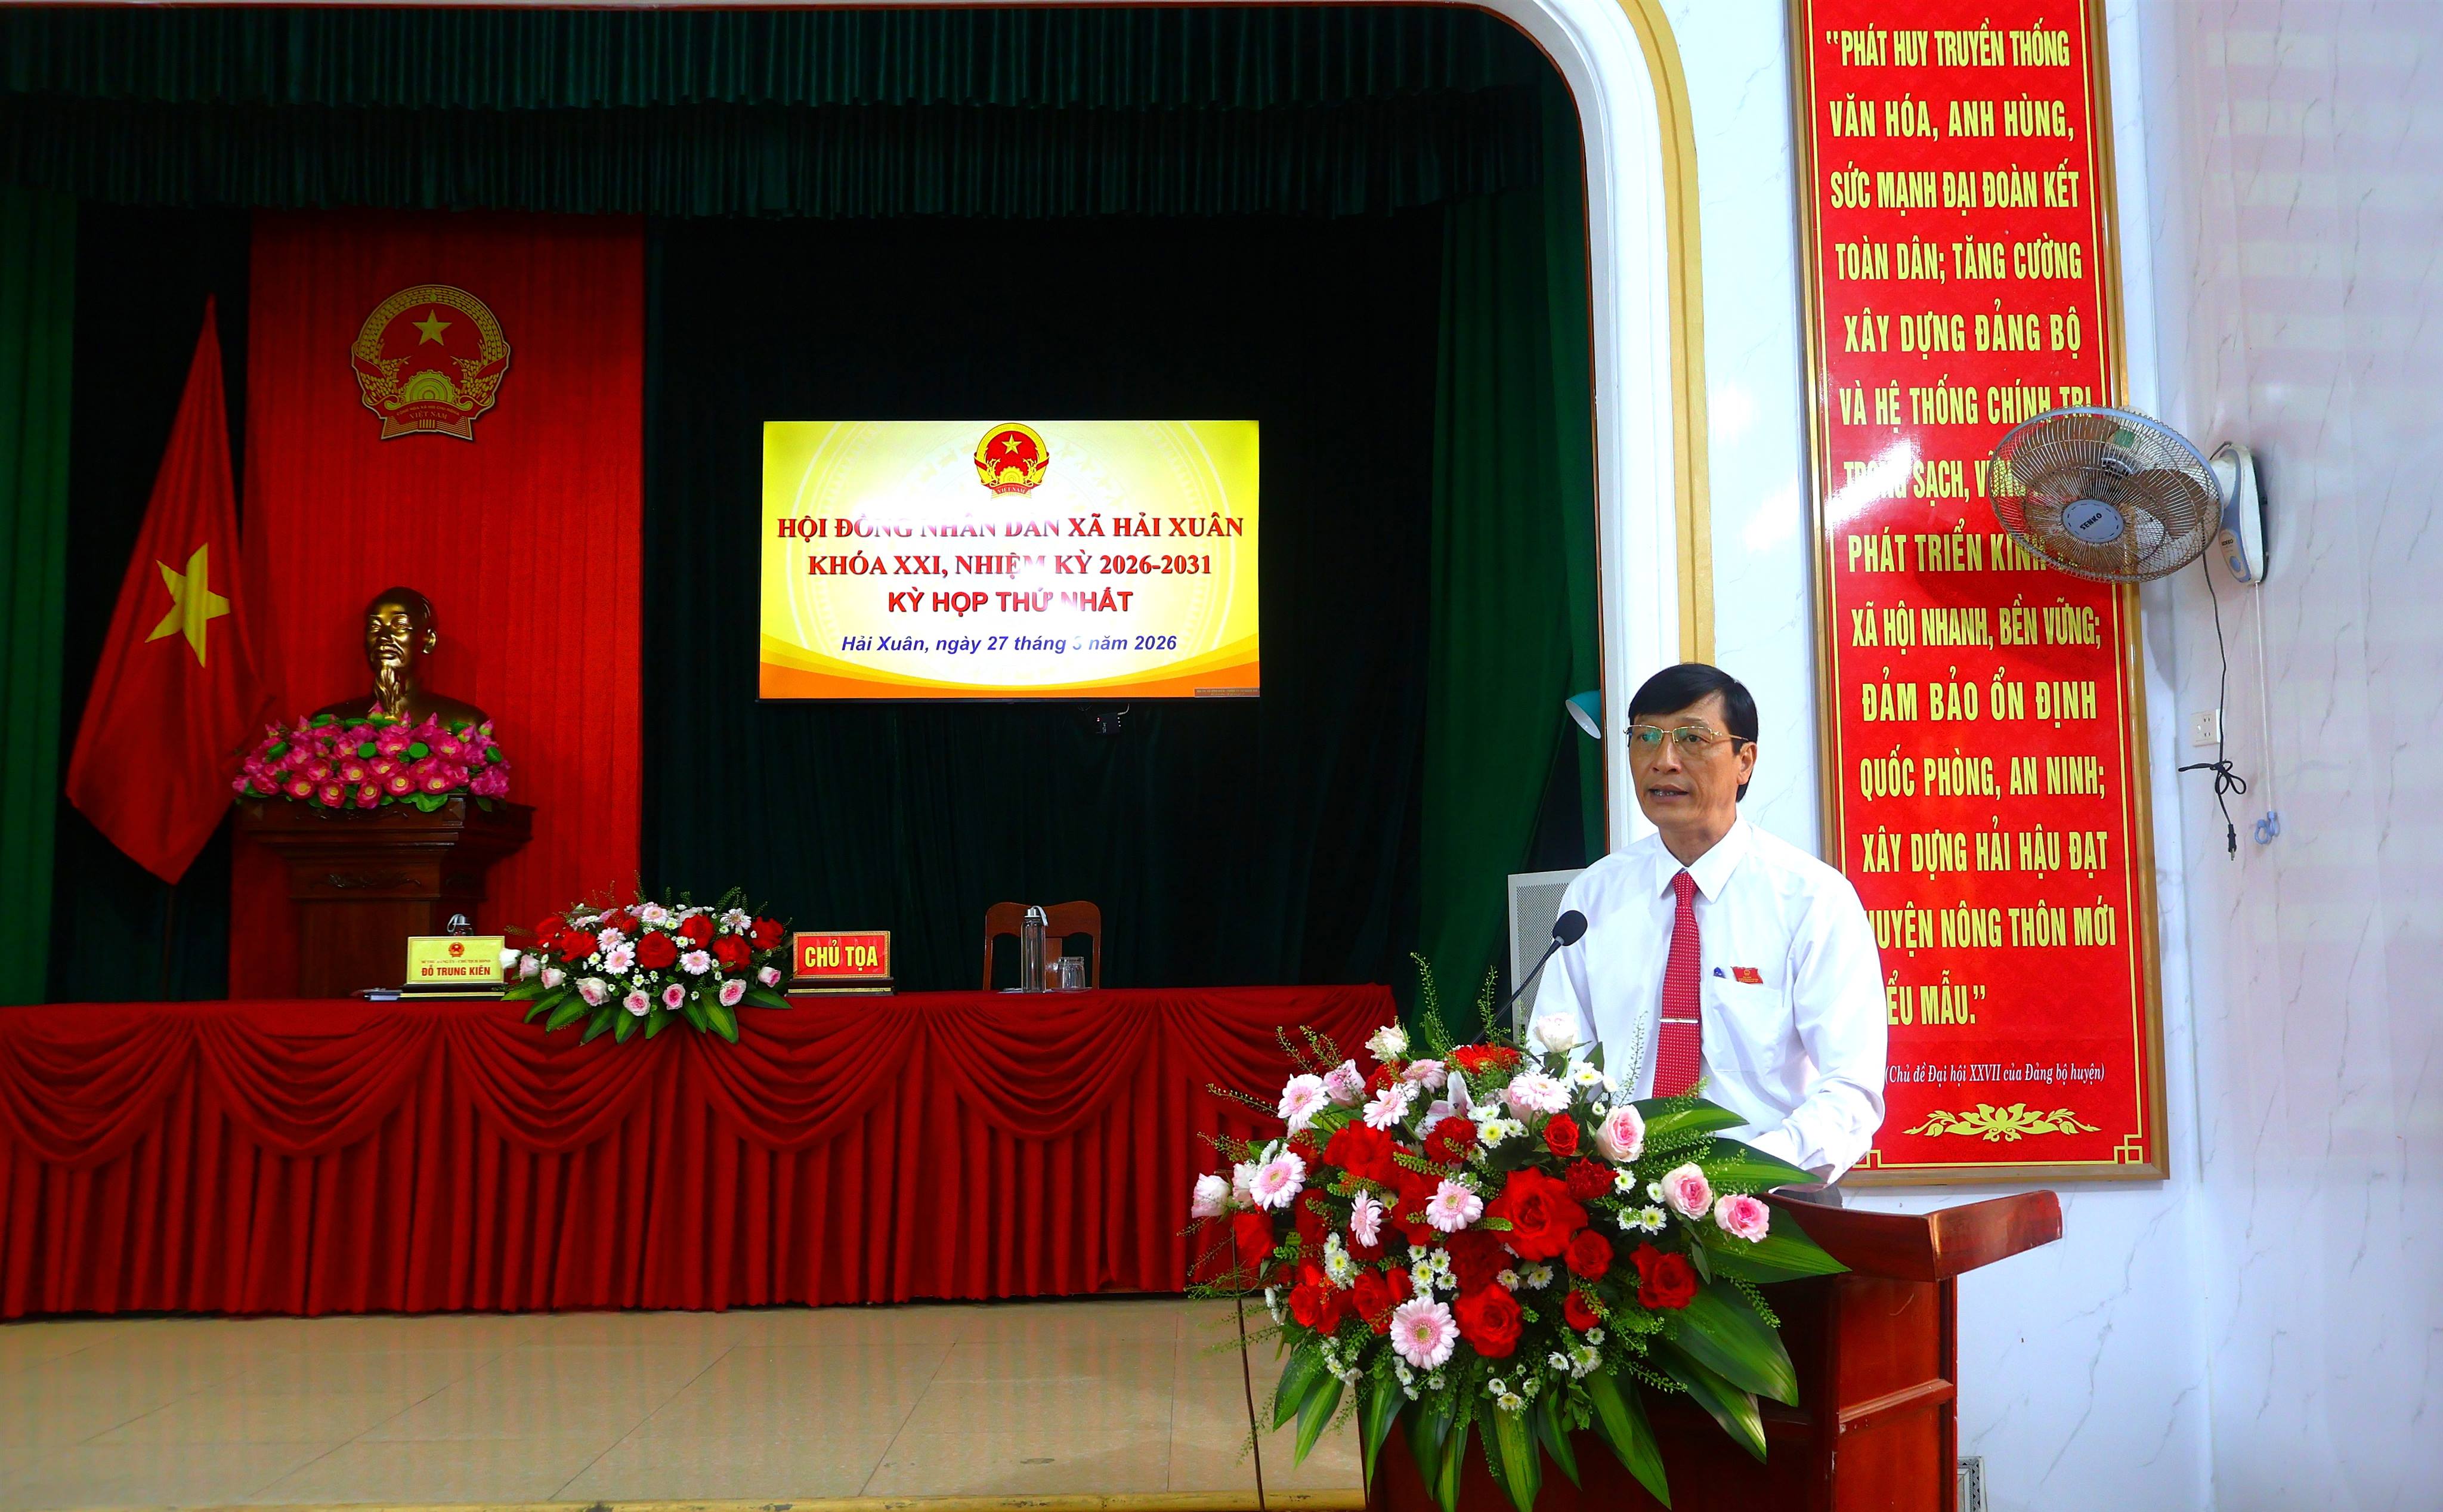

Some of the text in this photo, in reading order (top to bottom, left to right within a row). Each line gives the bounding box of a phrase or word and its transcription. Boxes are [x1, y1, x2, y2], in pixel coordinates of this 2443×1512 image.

[1892, 30, 1929, 67] HUY
[1933, 17, 2005, 67] TRUYỀN
[2008, 17, 2071, 67] THỐNG
[1829, 92, 2074, 143] VĂN HÓA, ANH HÙNG,
[1830, 157, 2080, 217] SỨC MẠNH ĐẠI ĐOÀN KẾT
[1834, 231, 2083, 285] TOÀN DÂN; TĂNG CƯỜNG
[1843, 298, 2082, 361] XÂY DỰNG ĐẢNG BỘ
[1839, 379, 1867, 426] VÀ
[1874, 379, 1901, 434] HỆ
[1908, 373, 1979, 426] THỐNG
[1986, 378, 2052, 425] CHÍNH
[1911, 458, 1970, 508] SẠCH,
[777, 514, 828, 544] HỘI
[1067, 512, 1106, 537] XÃ
[1112, 511, 1162, 537] HẢI
[1167, 511, 1244, 538] XUÂN
[1847, 524, 1907, 573] PHÁT
[1913, 517, 1983, 572] TRIỂN
[2080, 513, 2102, 530] SENKO
[807, 548, 1212, 580] KHÓA XXI, NHIỆM KỲ 2026-2031
[887, 586, 1134, 619] KỲ HỌP THỨ NHẤT
[1850, 593, 2101, 655] XÃ HỘI NHANH, BỀN VỮNG;
[841, 635, 873, 652] Hải
[876, 635, 929, 654] Xuân,
[935, 635, 982, 655] ngày
[987, 635, 1010, 651] 27
[1013, 635, 1067, 655] tháng
[1088, 635, 1128, 651] năm
[1133, 635, 1177, 651] 2026
[1861, 664, 2097, 729] ĐẢM BẢO ỔN ĐỊNH
[1860, 743, 2105, 802] QUỐC PHÒNG, AN NINH;
[1861, 814, 2108, 881] XÂY DỰNG HẢI HẬU ĐẠT
[1940, 899, 2003, 948] NÔNG
[2007, 898, 2067, 948] THÔN
[2073, 894, 2117, 947] MỚI
[437, 967, 466, 976] TRUNG
[469, 964, 491, 975] KIÊN
[804, 939, 879, 972] CHỦ TỌA
[1885, 969, 1913, 1026] ỂU
[1884, 1060, 2105, 1088] (Chủ đề Đại hội XXVII của Đảng bộ huyện)
